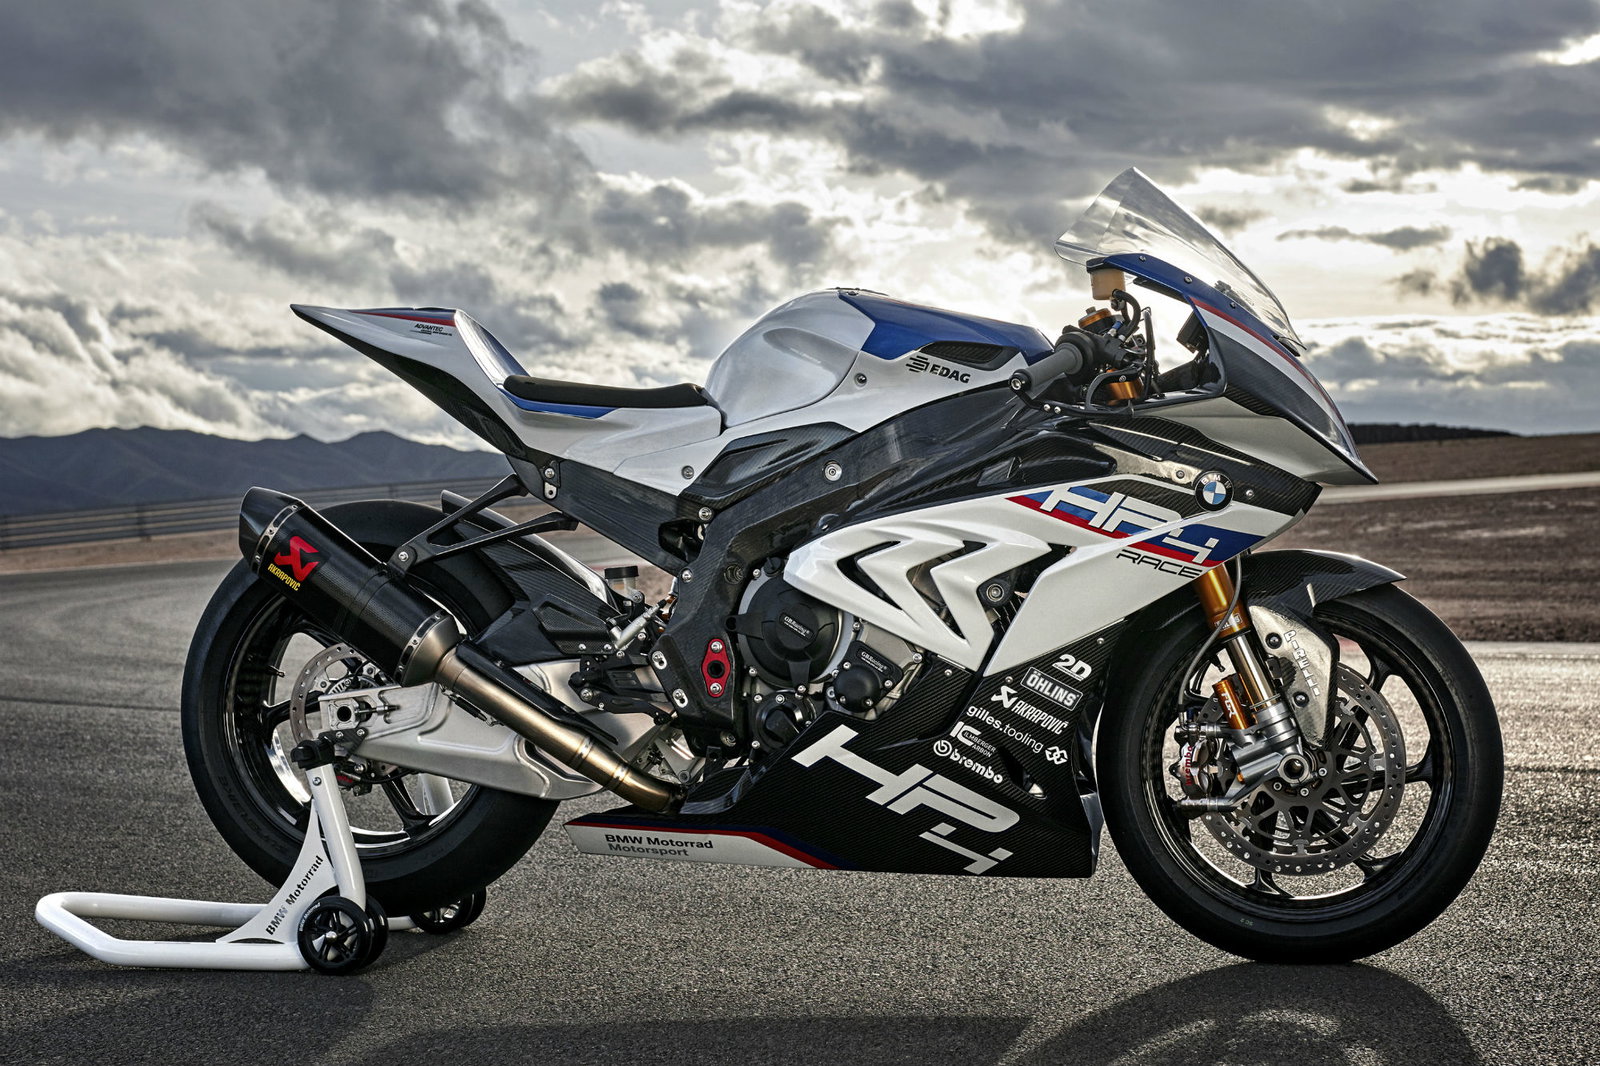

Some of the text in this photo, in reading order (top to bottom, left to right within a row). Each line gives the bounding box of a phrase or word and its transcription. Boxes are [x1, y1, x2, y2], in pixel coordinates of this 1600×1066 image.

[415, 323, 444, 332] ADVANTEC
[929, 364, 971, 384] EDAG
[1201, 474, 1232, 489] BMW
[1116, 549, 1203, 578] RACE
[1052, 654, 1092, 681] 2D
[1284, 630, 1320, 696] PIRELLI
[1026, 670, 1077, 707] ÖHLINS
[950, 748, 1003, 784] brembo
[605, 834, 713, 849] BMW Motorrad
[608, 843, 689, 856] Motorsport
[265, 905, 288, 936] BMW
[285, 855, 324, 906] Motorrad
